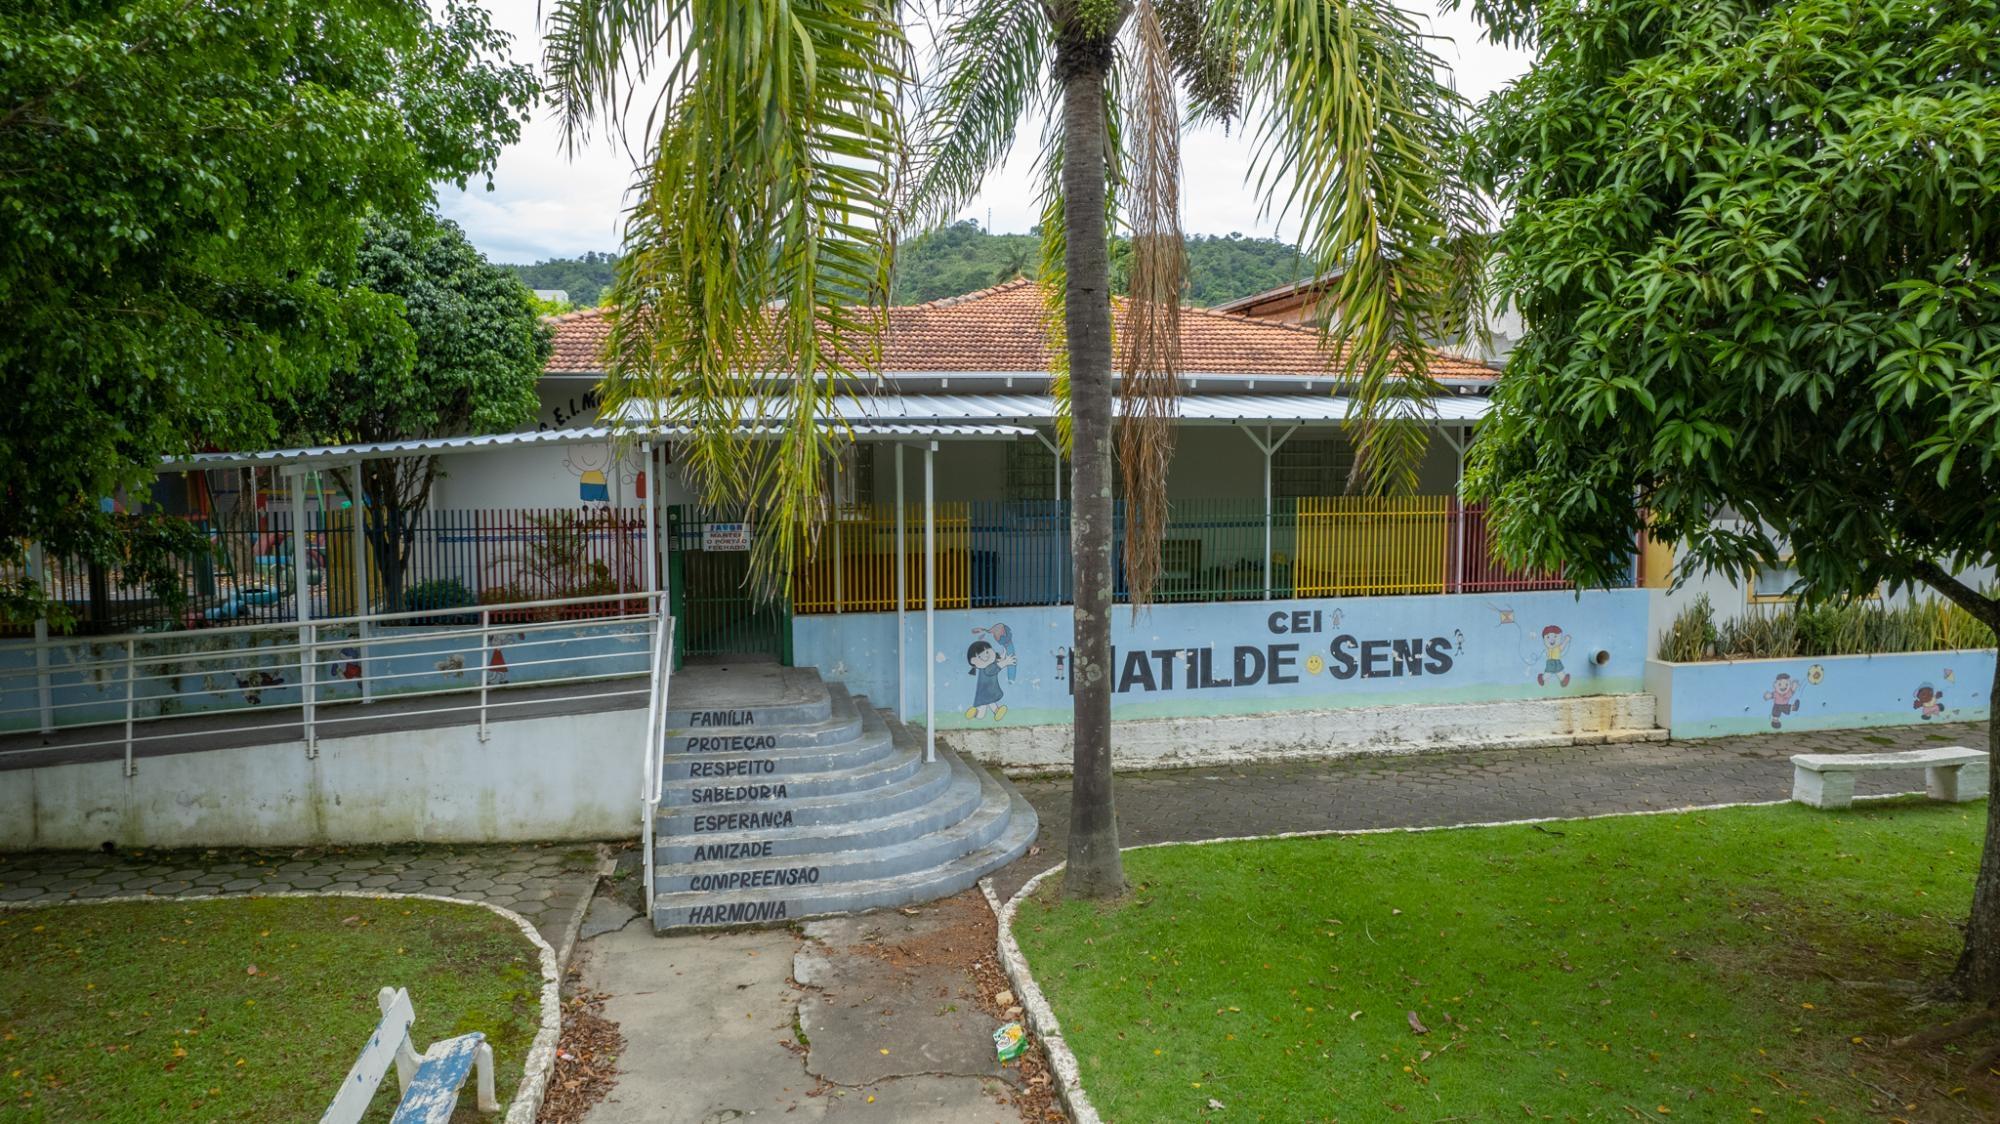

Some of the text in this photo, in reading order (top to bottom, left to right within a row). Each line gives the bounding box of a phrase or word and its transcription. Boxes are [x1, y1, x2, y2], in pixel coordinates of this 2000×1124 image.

[1268, 610, 1322, 634] CEI
[1069, 634, 1454, 696] ATILDE SENS
[690, 710, 754, 727] FAMÍLIA
[690, 759, 775, 777] RESPEITO
[692, 784, 787, 803] SABEDORIA
[694, 810, 793, 832] ESPERANÇA
[694, 841, 773, 861] AMIZADE
[689, 901, 787, 924] HARMONIA
